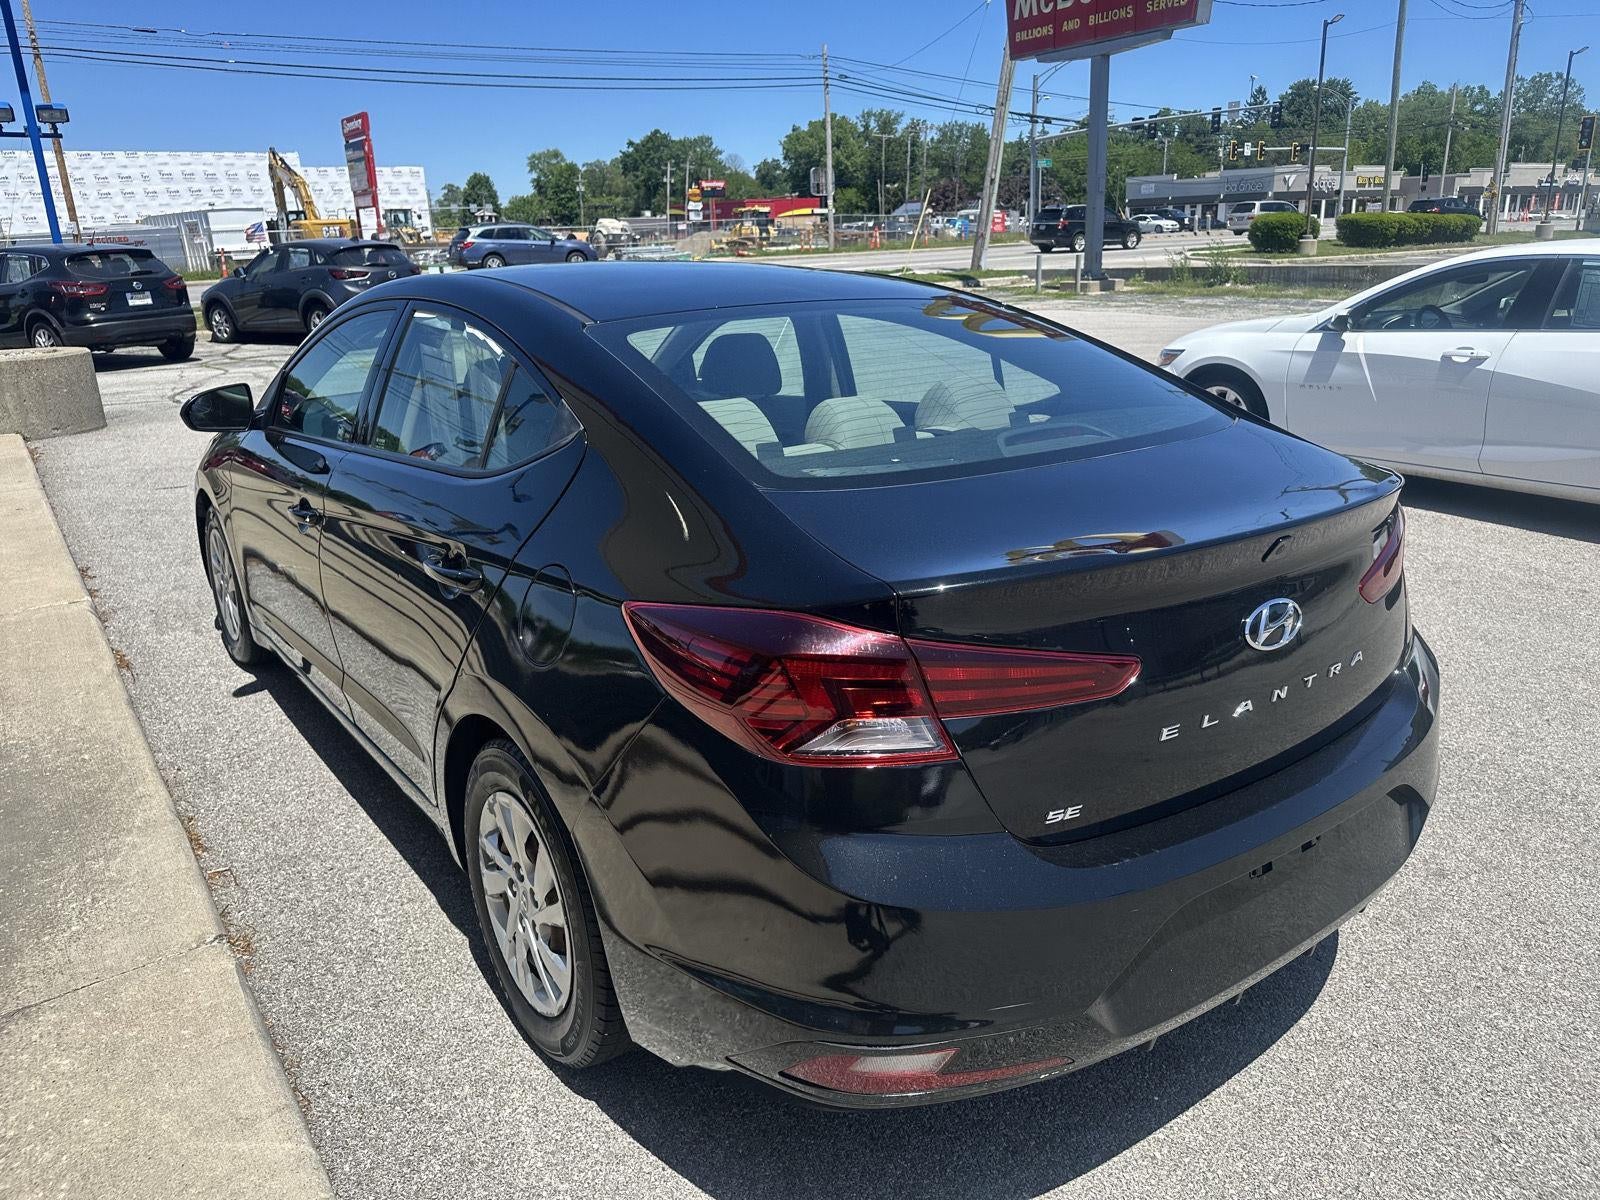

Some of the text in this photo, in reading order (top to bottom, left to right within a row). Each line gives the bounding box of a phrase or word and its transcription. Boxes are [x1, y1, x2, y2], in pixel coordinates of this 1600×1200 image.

[1015, 24, 1054, 42] BILLIONS
[1062, 18, 1081, 32] AND
[1088, 5, 1134, 26] BILLIONS
[1159, 650, 1364, 742] ELANTRA
[1045, 805, 1083, 825] SE
